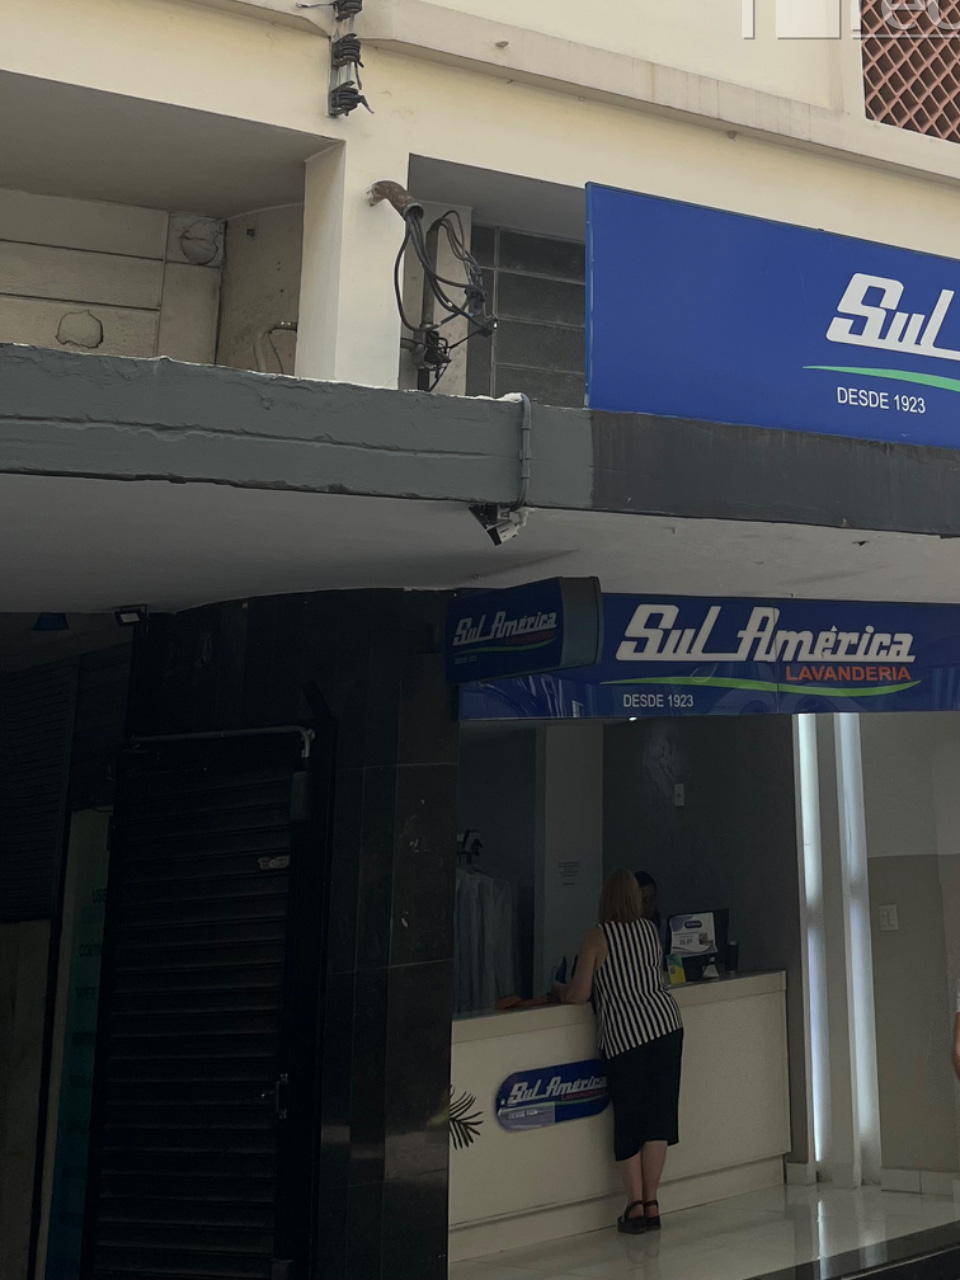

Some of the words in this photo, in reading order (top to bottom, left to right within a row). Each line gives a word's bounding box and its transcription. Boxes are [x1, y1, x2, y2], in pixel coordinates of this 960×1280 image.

[837, 386, 890, 410] DESDE
[894, 394, 926, 414] 1923
[452, 615, 494, 646] Sul
[616, 604, 741, 661] Sul
[786, 665, 911, 682] LAVANDERIA
[623, 694, 664, 708] DESDE
[668, 694, 694, 708] 1923
[507, 1079, 549, 1103] Sul
